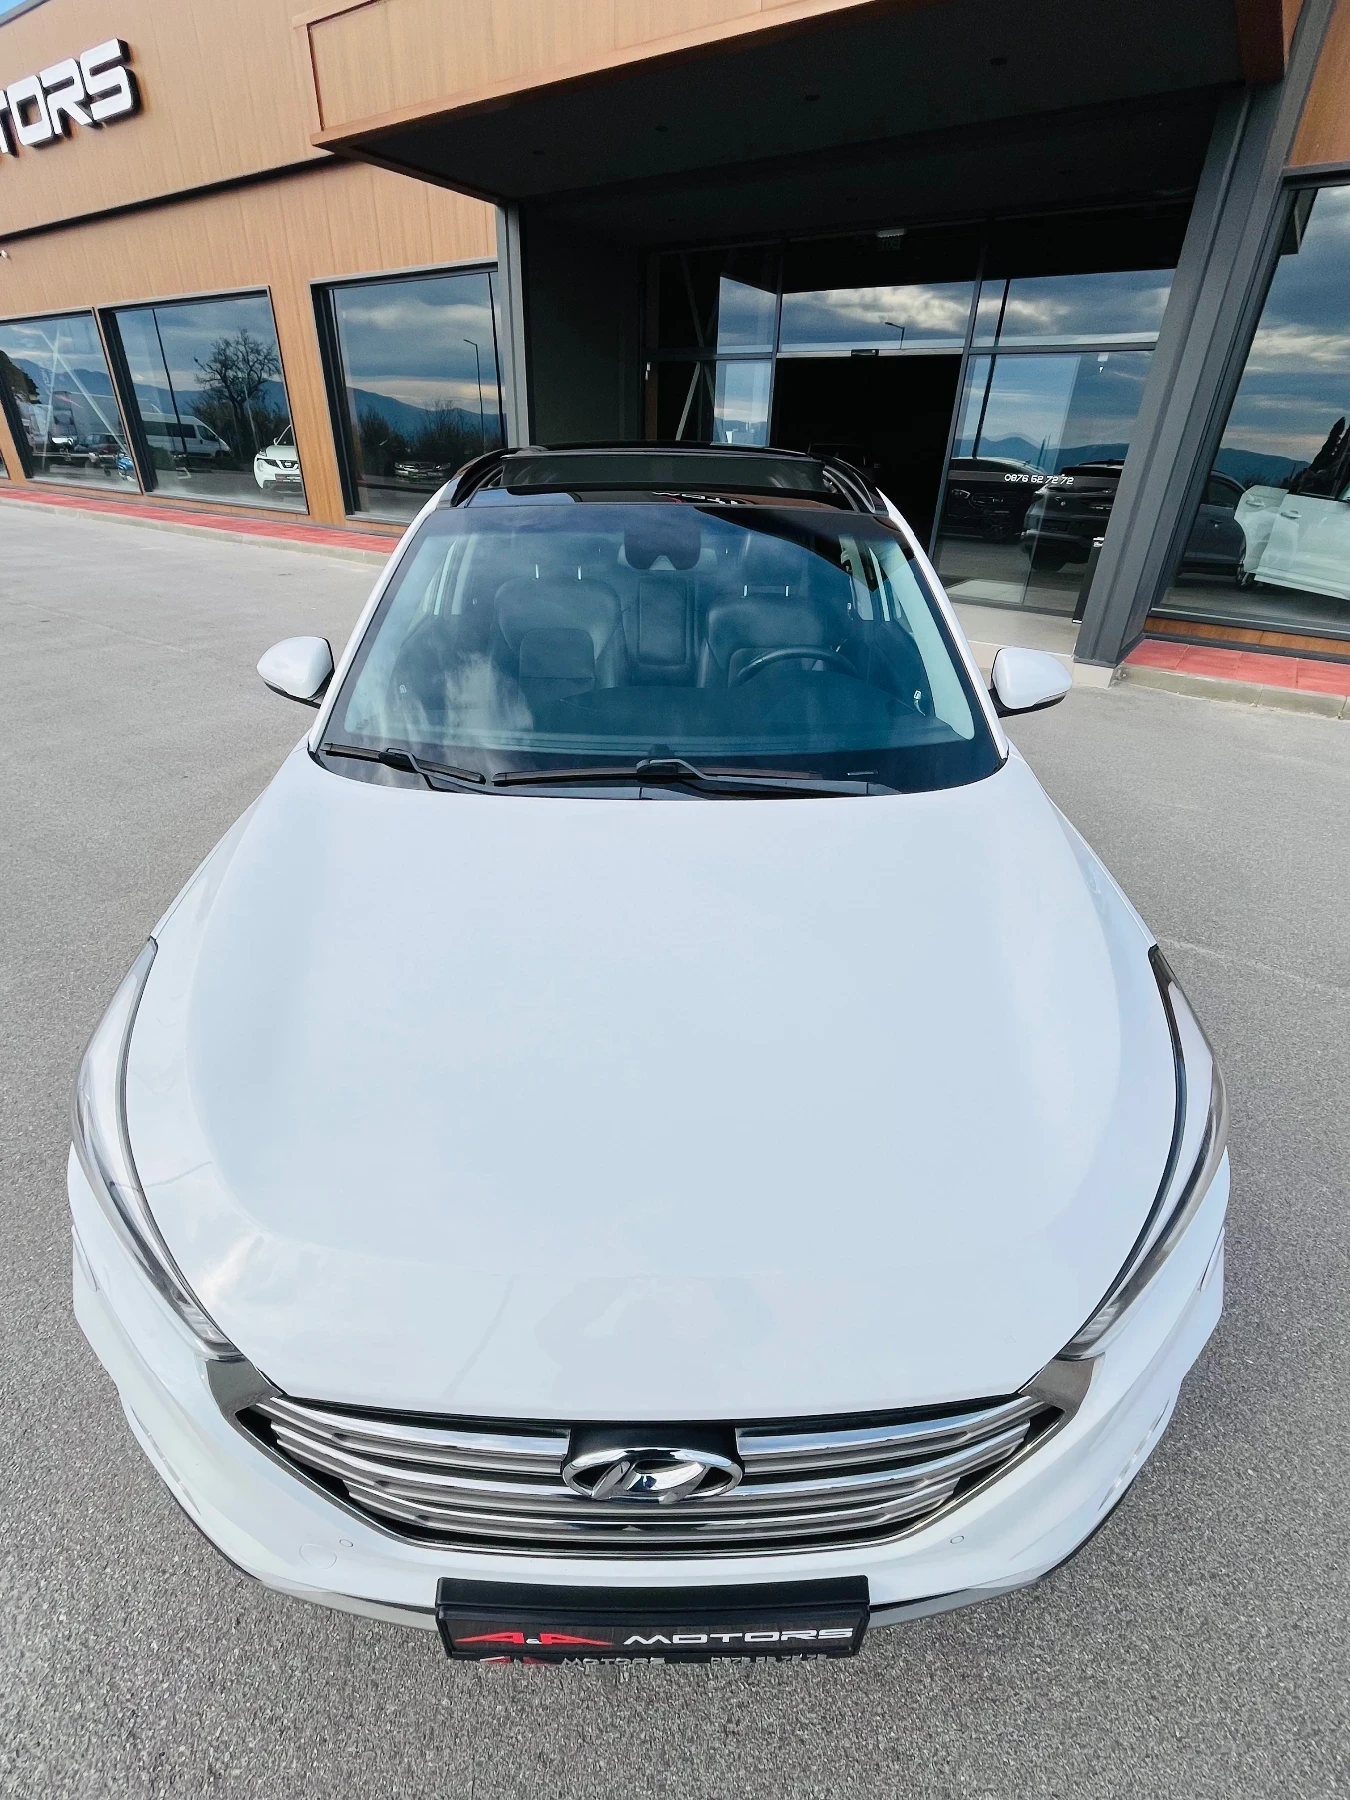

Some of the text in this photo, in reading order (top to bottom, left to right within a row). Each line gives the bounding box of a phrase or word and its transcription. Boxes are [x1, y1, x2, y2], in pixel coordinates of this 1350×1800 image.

[1004, 473, 1029, 483] 0876
[1045, 475, 1059, 484] 72
[1060, 476, 1075, 485] 72
[622, 1627, 854, 1645] MOTORS
